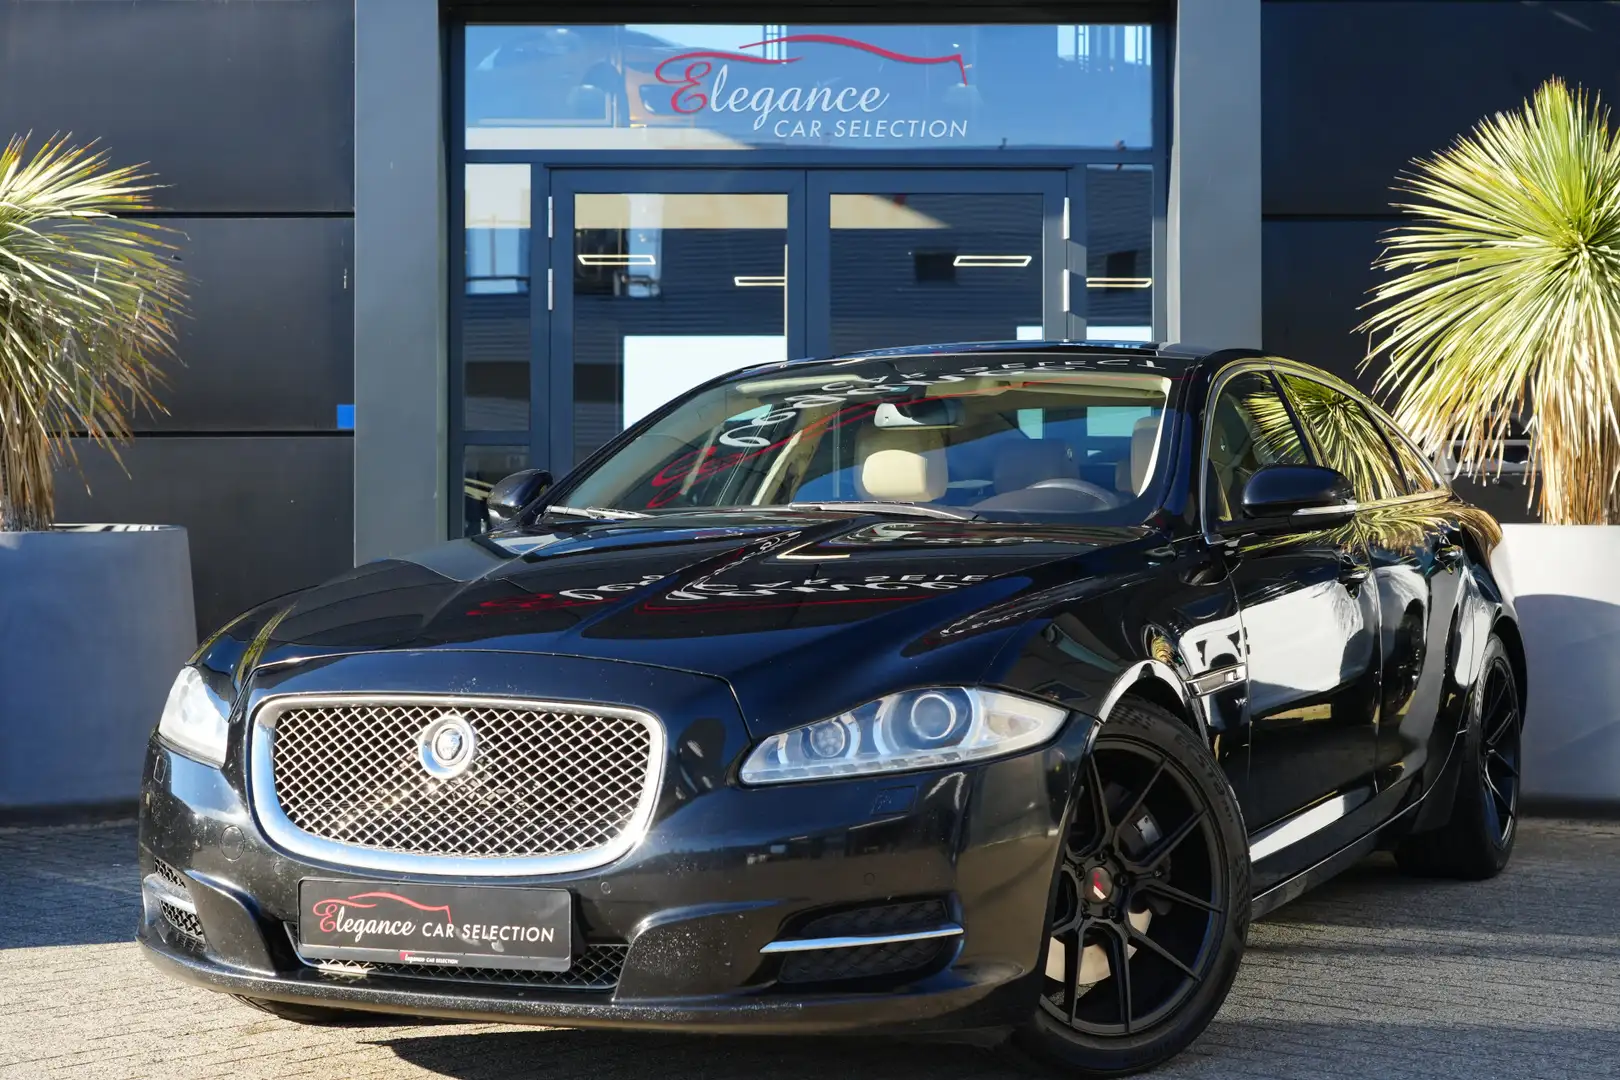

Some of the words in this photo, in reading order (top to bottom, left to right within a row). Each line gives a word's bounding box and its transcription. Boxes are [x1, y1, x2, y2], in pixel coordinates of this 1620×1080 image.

[655, 52, 890, 131] Elegance
[774, 120, 822, 138] CAR
[834, 120, 968, 138] SELECTION
[313, 899, 416, 942] Elegance
[422, 922, 455, 938] CAR
[461, 924, 555, 943] SELECTION
